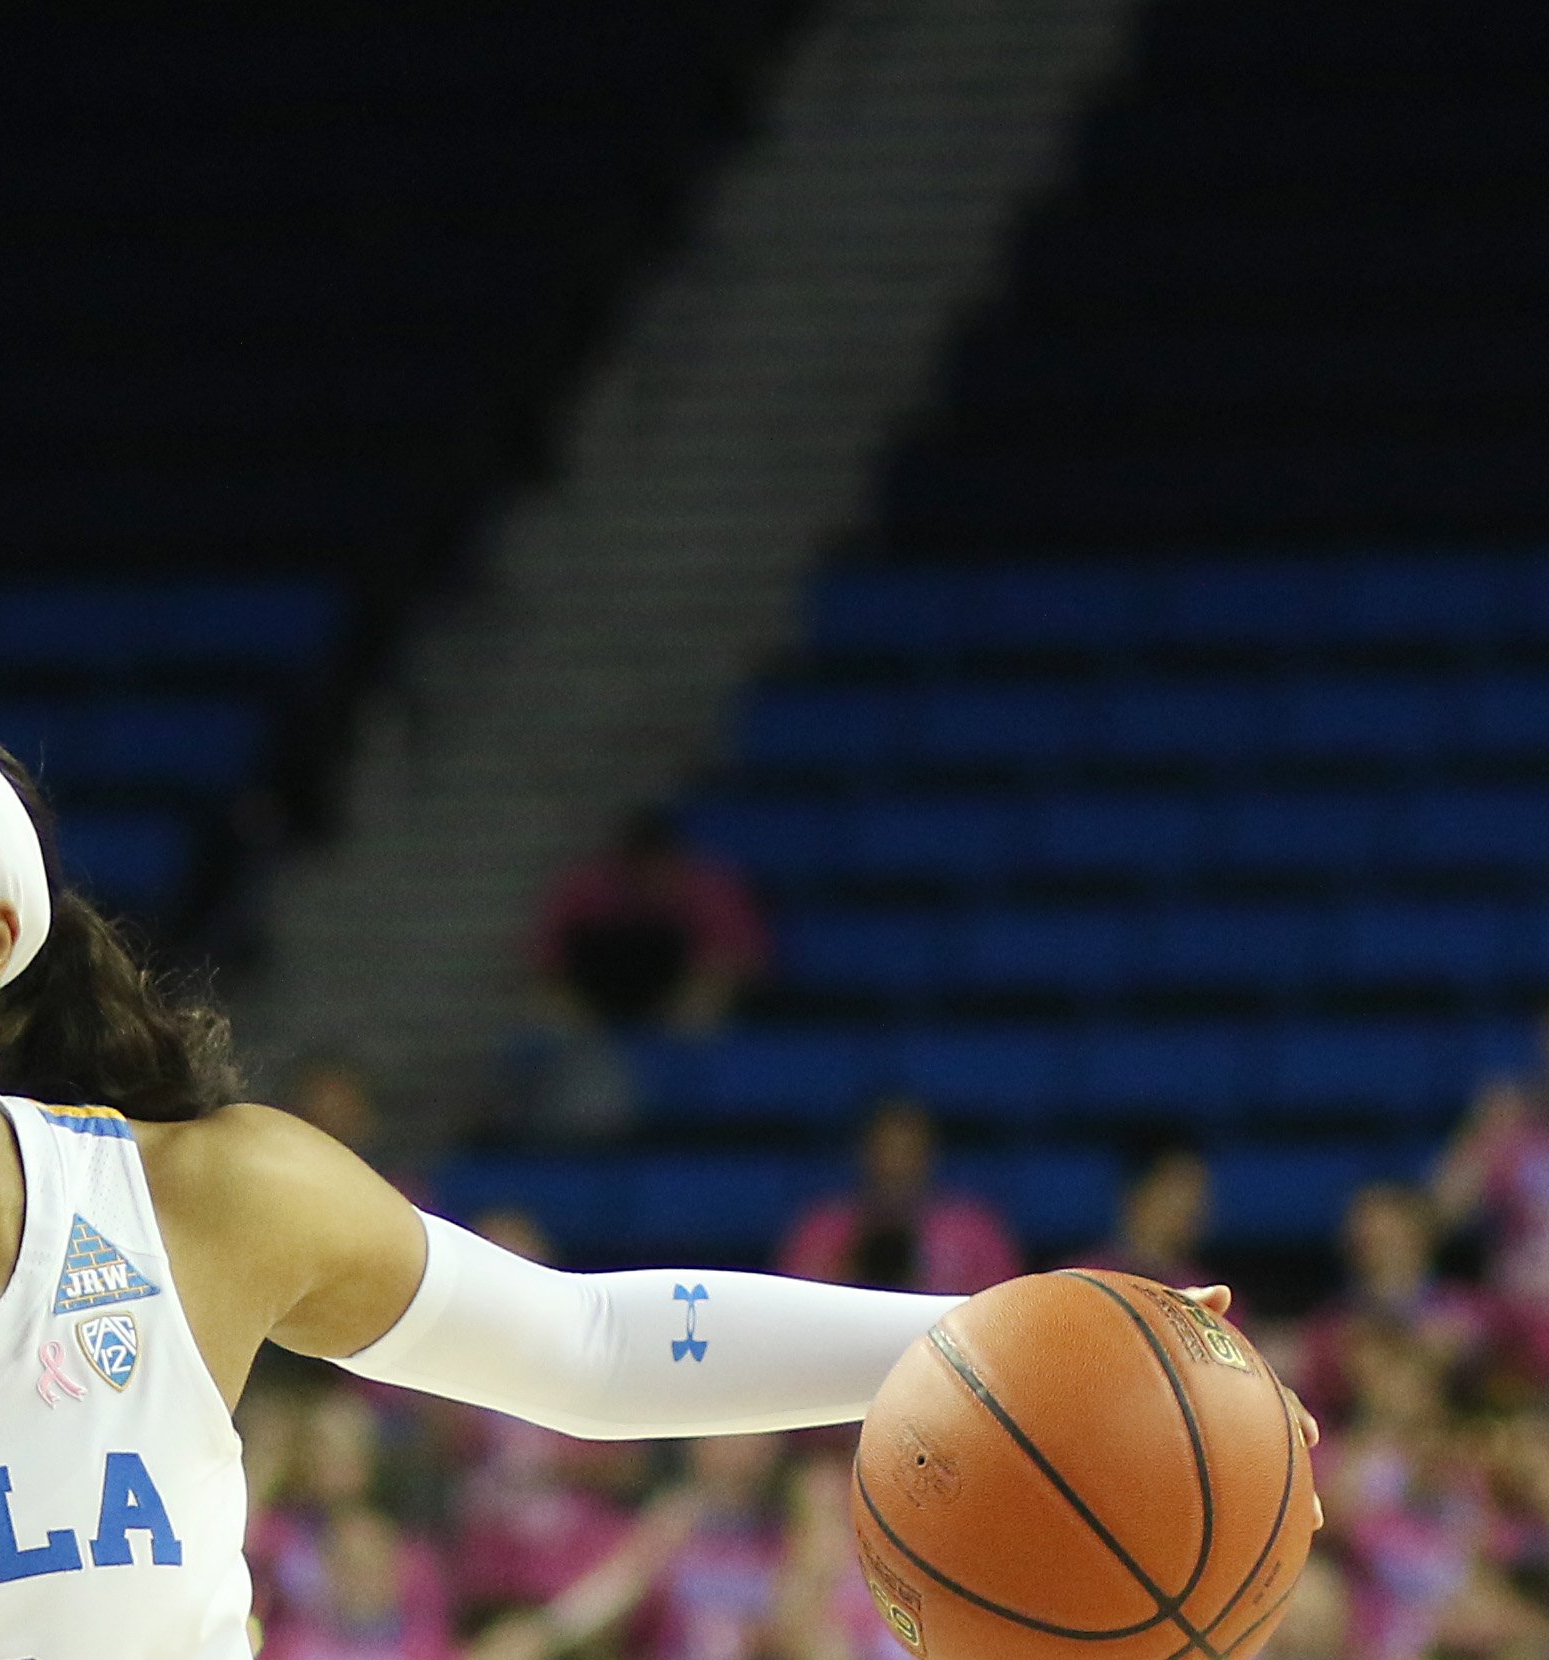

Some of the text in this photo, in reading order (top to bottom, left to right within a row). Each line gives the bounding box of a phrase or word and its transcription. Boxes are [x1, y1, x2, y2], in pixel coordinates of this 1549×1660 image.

[64, 1264, 128, 1298] JRW
[81, 1315, 137, 1362] PAC
[101, 1344, 132, 1377] 12
